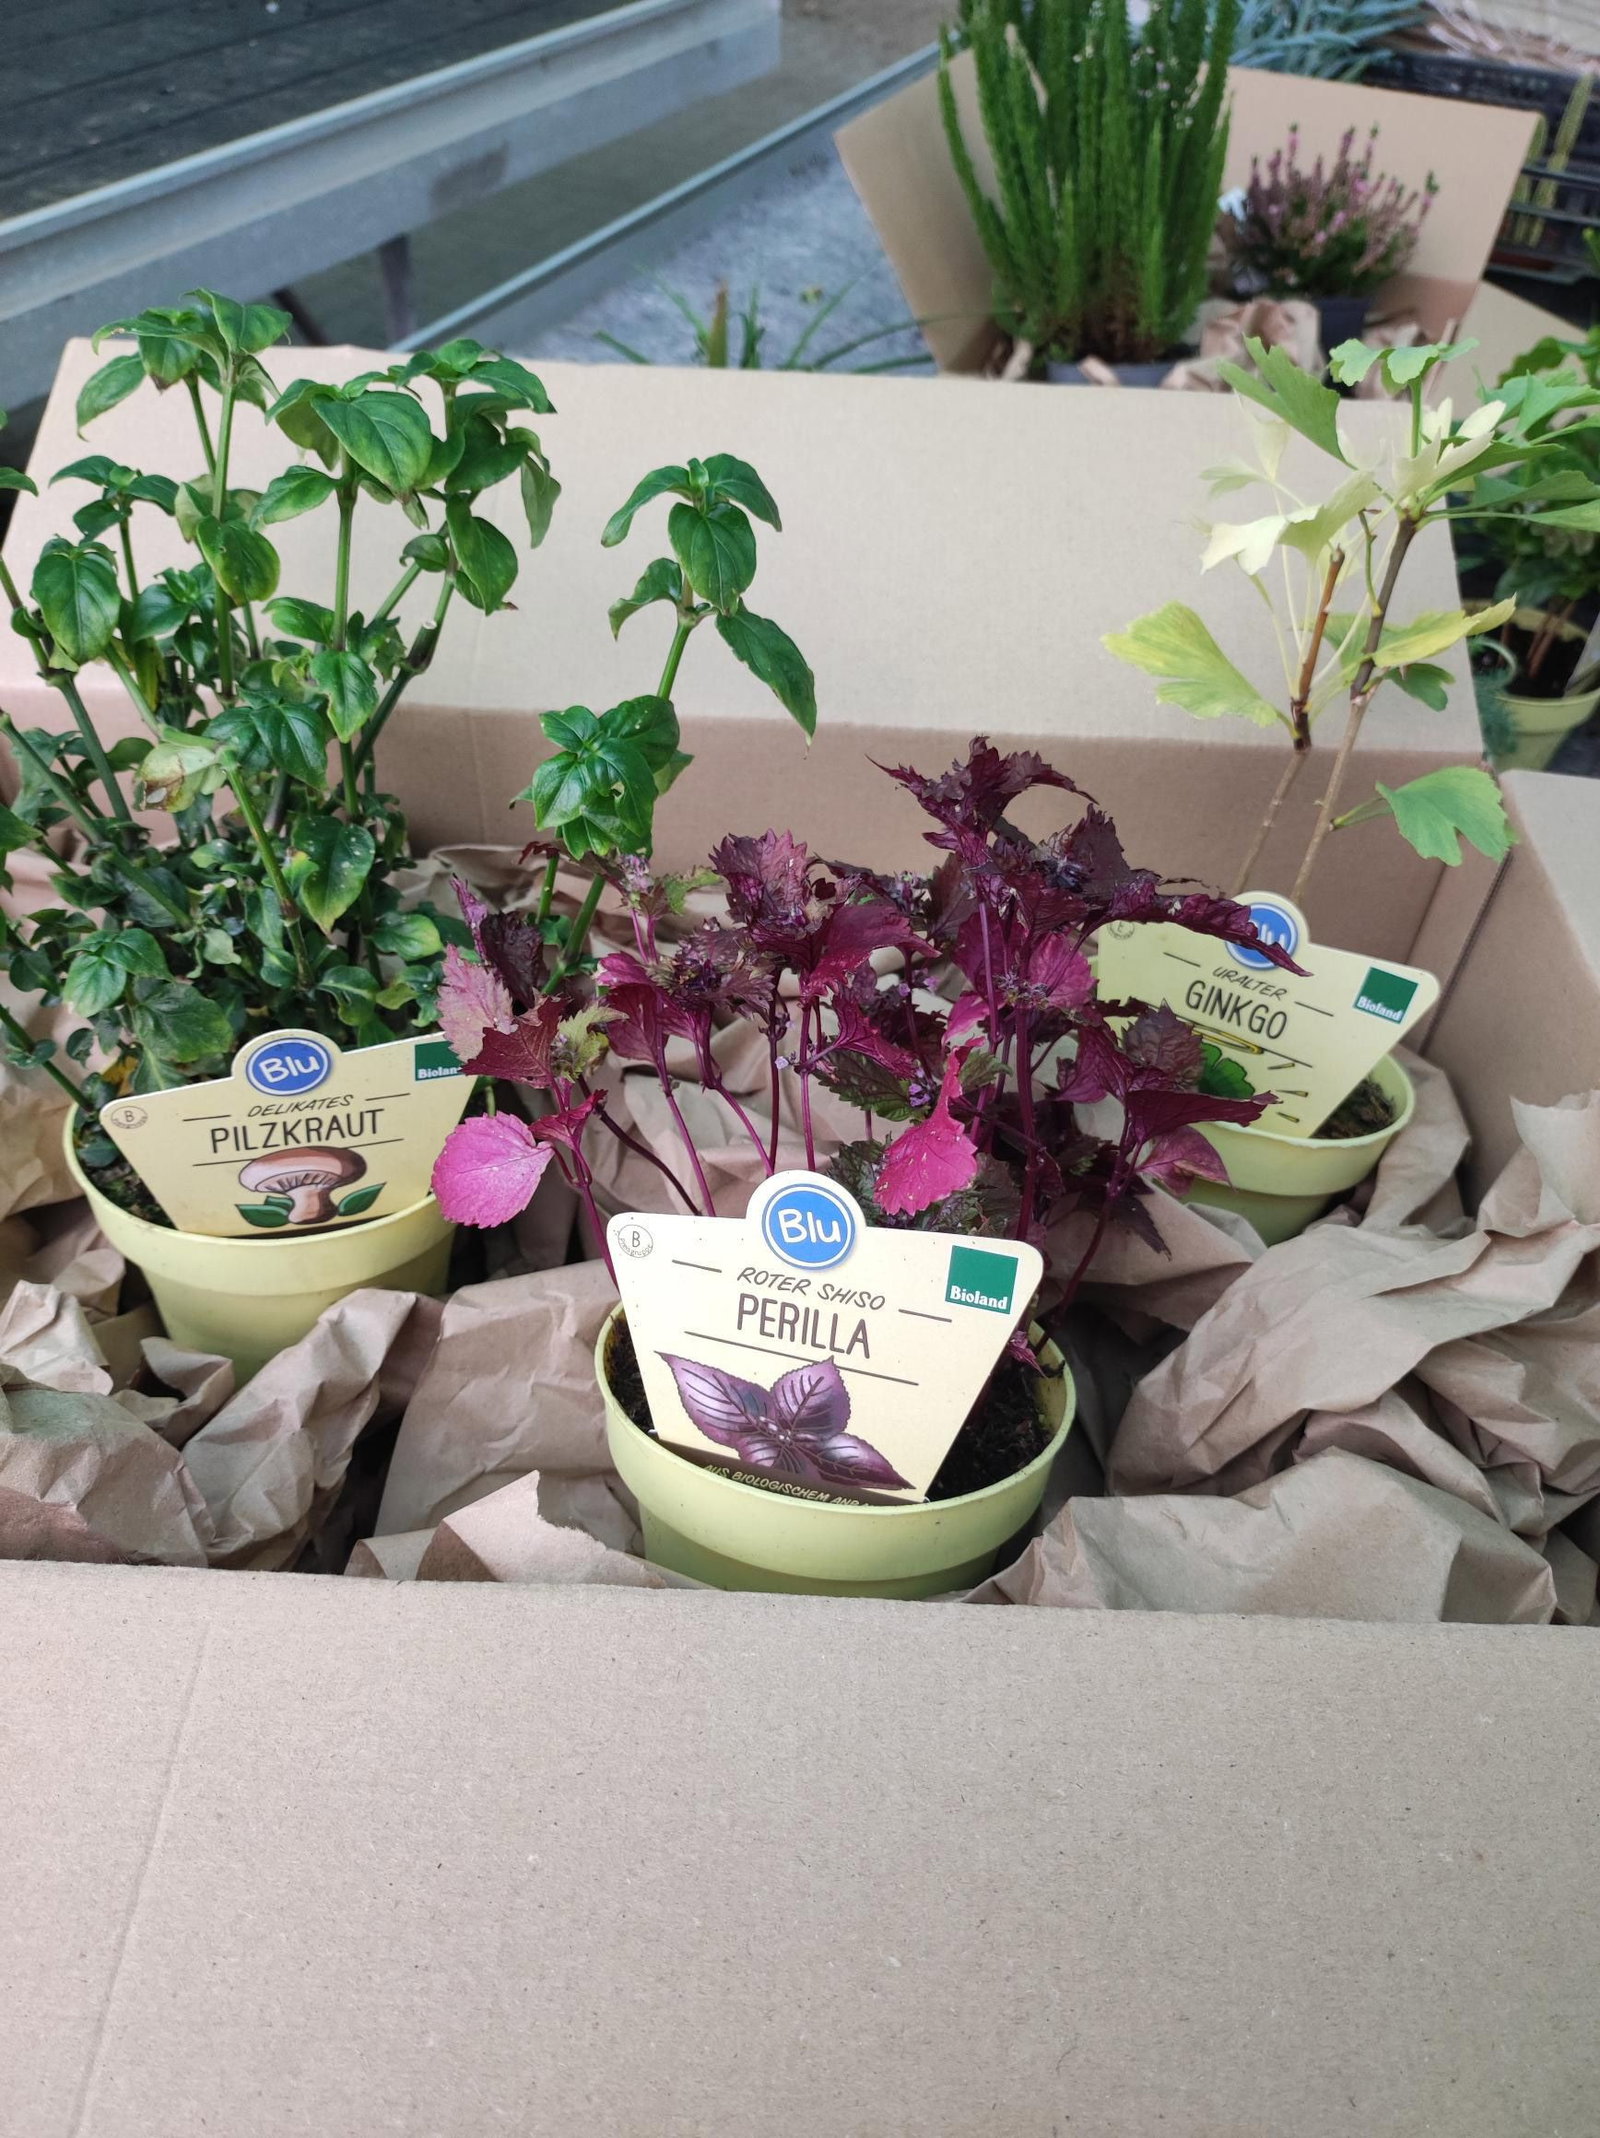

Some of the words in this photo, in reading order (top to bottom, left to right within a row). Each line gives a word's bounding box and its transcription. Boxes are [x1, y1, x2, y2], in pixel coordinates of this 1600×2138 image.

[1213, 966, 1287, 1001] URALTER
[1186, 980, 1287, 1040] GINKGO
[1357, 996, 1402, 1021] Bioland
[259, 1054, 320, 1084] Blu
[418, 1066, 463, 1079] Biolan
[124, 1110, 135, 1122] B
[248, 1094, 354, 1118] DELIKATES
[211, 1109, 385, 1153] PILZKRAUT
[632, 1231, 640, 1247] B
[778, 1209, 841, 1244] Blu
[737, 1267, 812, 1294] ROTER
[817, 1283, 885, 1311] SHISO
[950, 1285, 1008, 1311] Bioland
[737, 1293, 870, 1359] PERILLA
[704, 1464, 729, 1477] AUS
[732, 1471, 830, 1502] BIOLOGISCHEM
